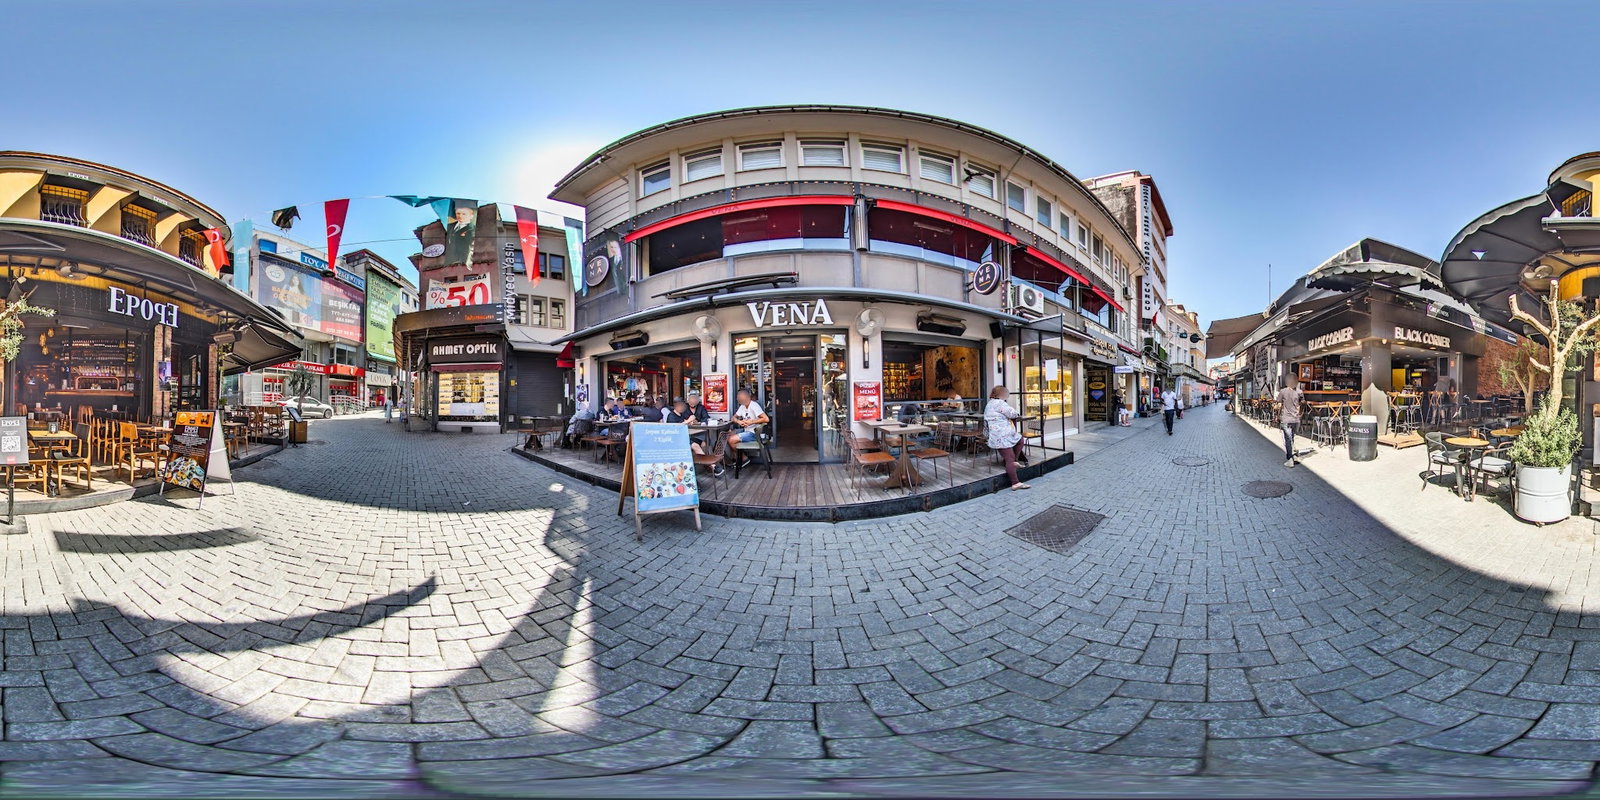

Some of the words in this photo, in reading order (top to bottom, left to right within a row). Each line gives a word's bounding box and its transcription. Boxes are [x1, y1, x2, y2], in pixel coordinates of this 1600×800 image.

[303, 255, 319, 268] TOY
[502, 242, 515, 269] Yasin
[503, 273, 518, 320] Midyeci
[747, 298, 834, 328] VENA
[432, 344, 465, 356] AHMET
[466, 341, 497, 355] OPTİK
[1308, 338, 1326, 351] BLACK
[1326, 327, 1354, 346] CORNER
[1394, 326, 1422, 343] BLACK
[1423, 332, 1451, 348] CORNER
